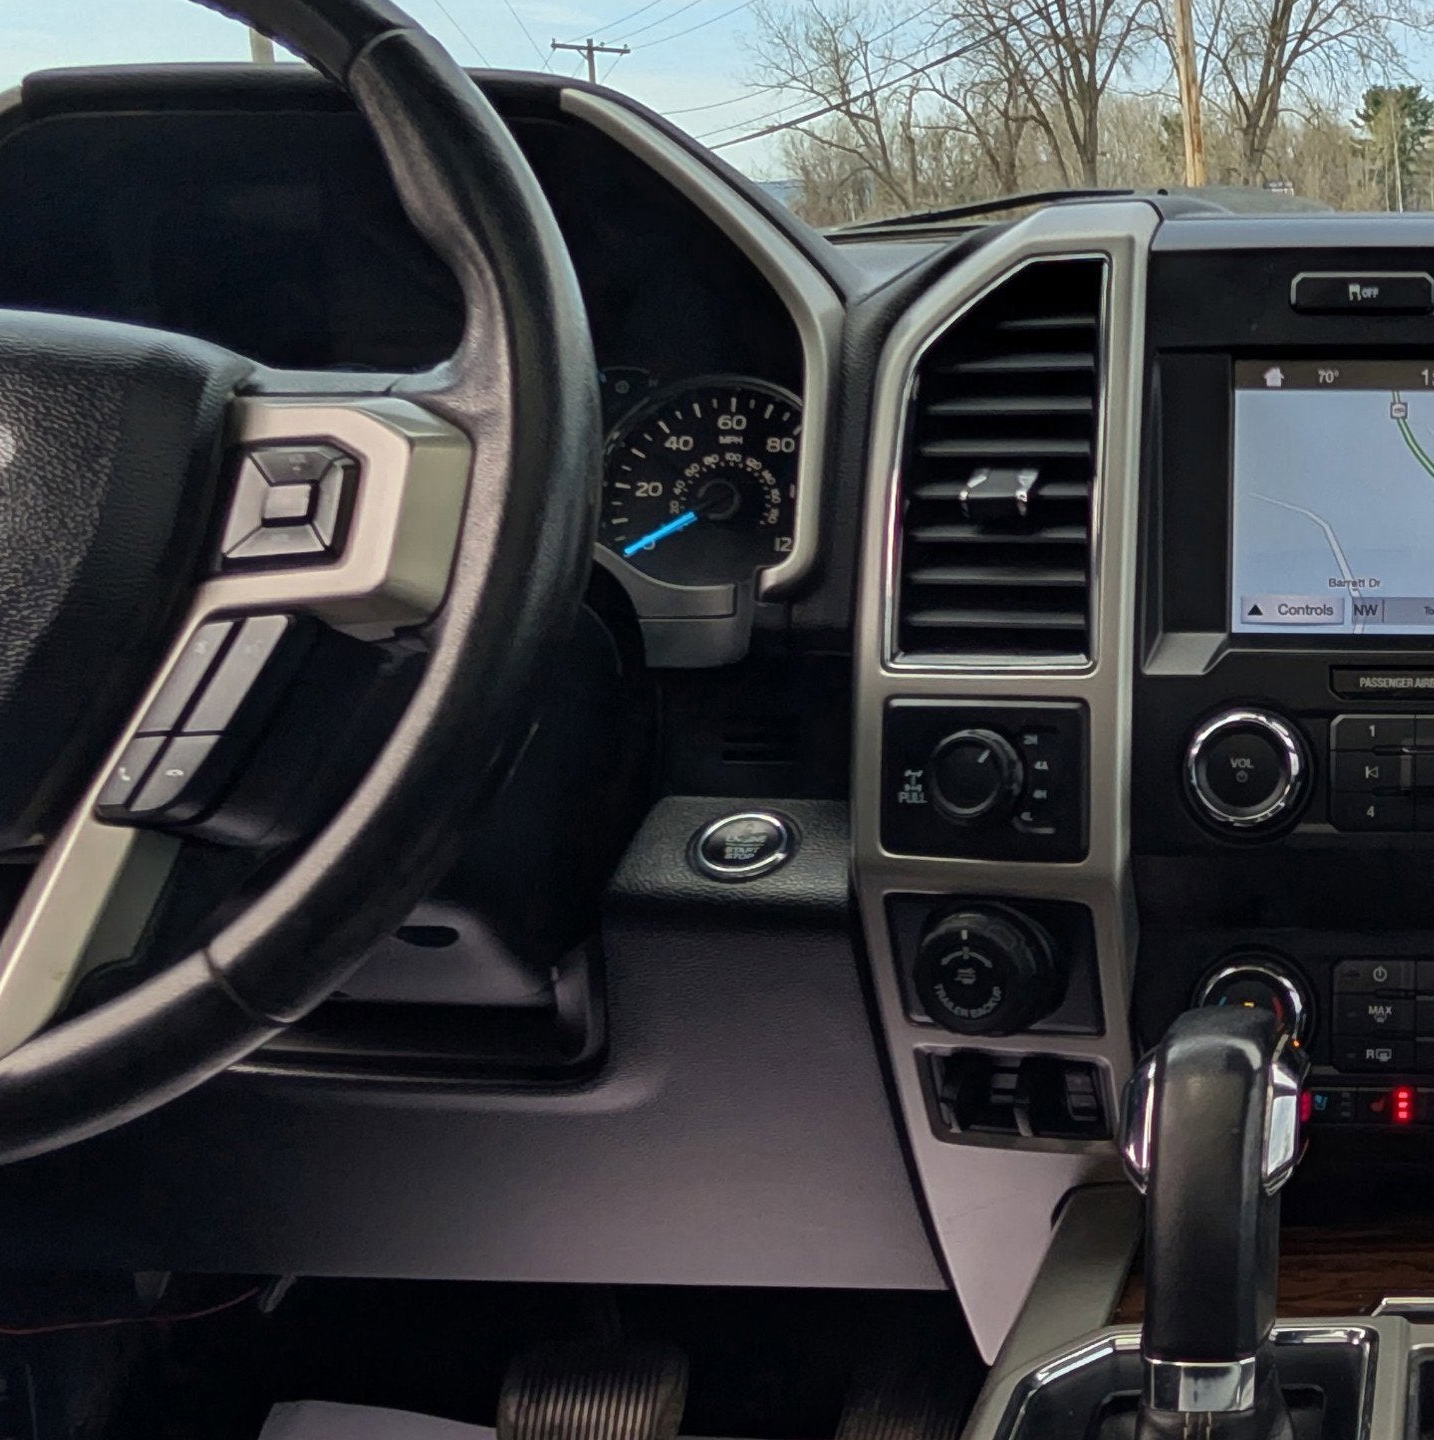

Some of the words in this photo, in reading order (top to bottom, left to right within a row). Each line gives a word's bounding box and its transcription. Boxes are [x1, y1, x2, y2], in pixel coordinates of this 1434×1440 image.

[717, 415, 747, 430] 60
[664, 436, 694, 451] 40
[719, 435, 743, 445] MPH
[767, 437, 795, 453] 80
[635, 482, 663, 497] 20
[1369, 578, 1381, 588] Dr
[1277, 603, 1334, 616] Controls
[1353, 604, 1379, 616] NW
[1359, 677, 1413, 689] PASSENGER
[1230, 758, 1255, 769] VOL
[1367, 806, 1375, 818] 4
[933, 983, 969, 1017] TRAILER
[969, 986, 1002, 1018] BACKUP
[1368, 1005, 1392, 1015] MAX
